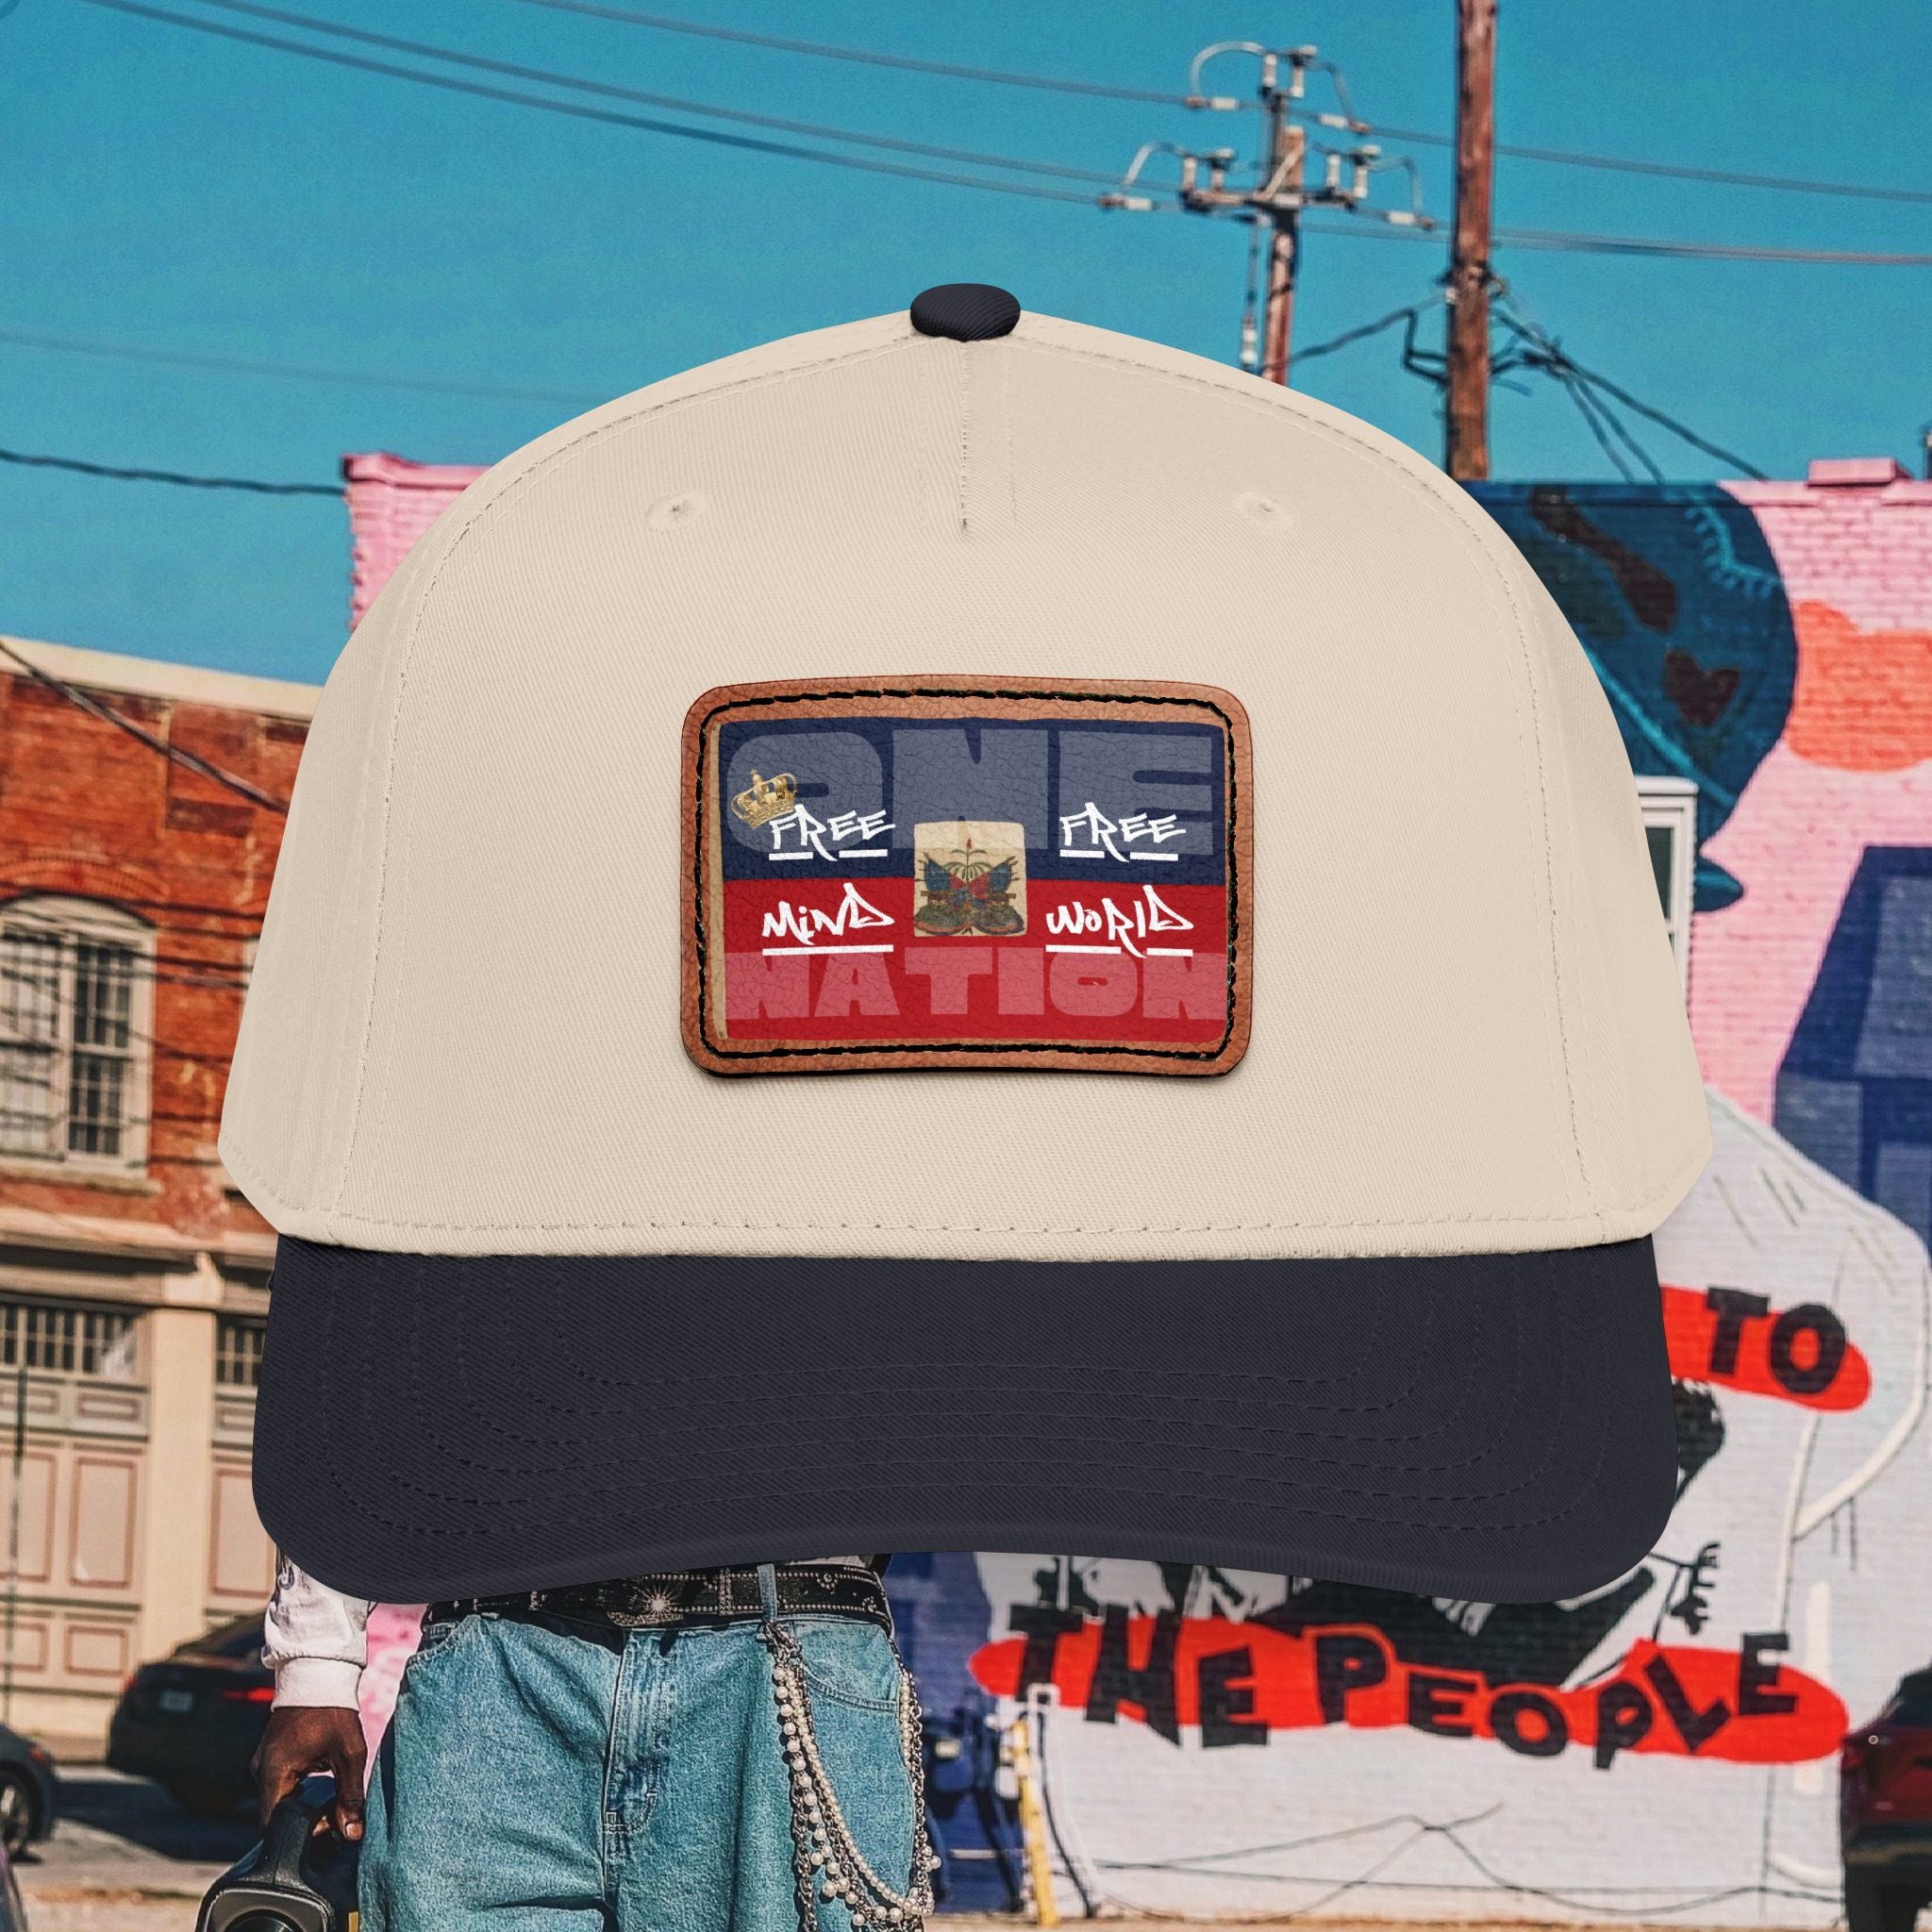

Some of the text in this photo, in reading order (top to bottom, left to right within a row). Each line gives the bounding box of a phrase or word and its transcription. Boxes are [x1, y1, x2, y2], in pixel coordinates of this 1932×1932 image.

[726, 728, 1213, 855] ONE
[769, 803, 896, 861] FREE
[1059, 803, 1186, 862] FREE
[724, 947, 1226, 1020] NATION
[1707, 1286, 1847, 1395] TO
[1008, 1603, 1800, 1770] THE PEOPLE
